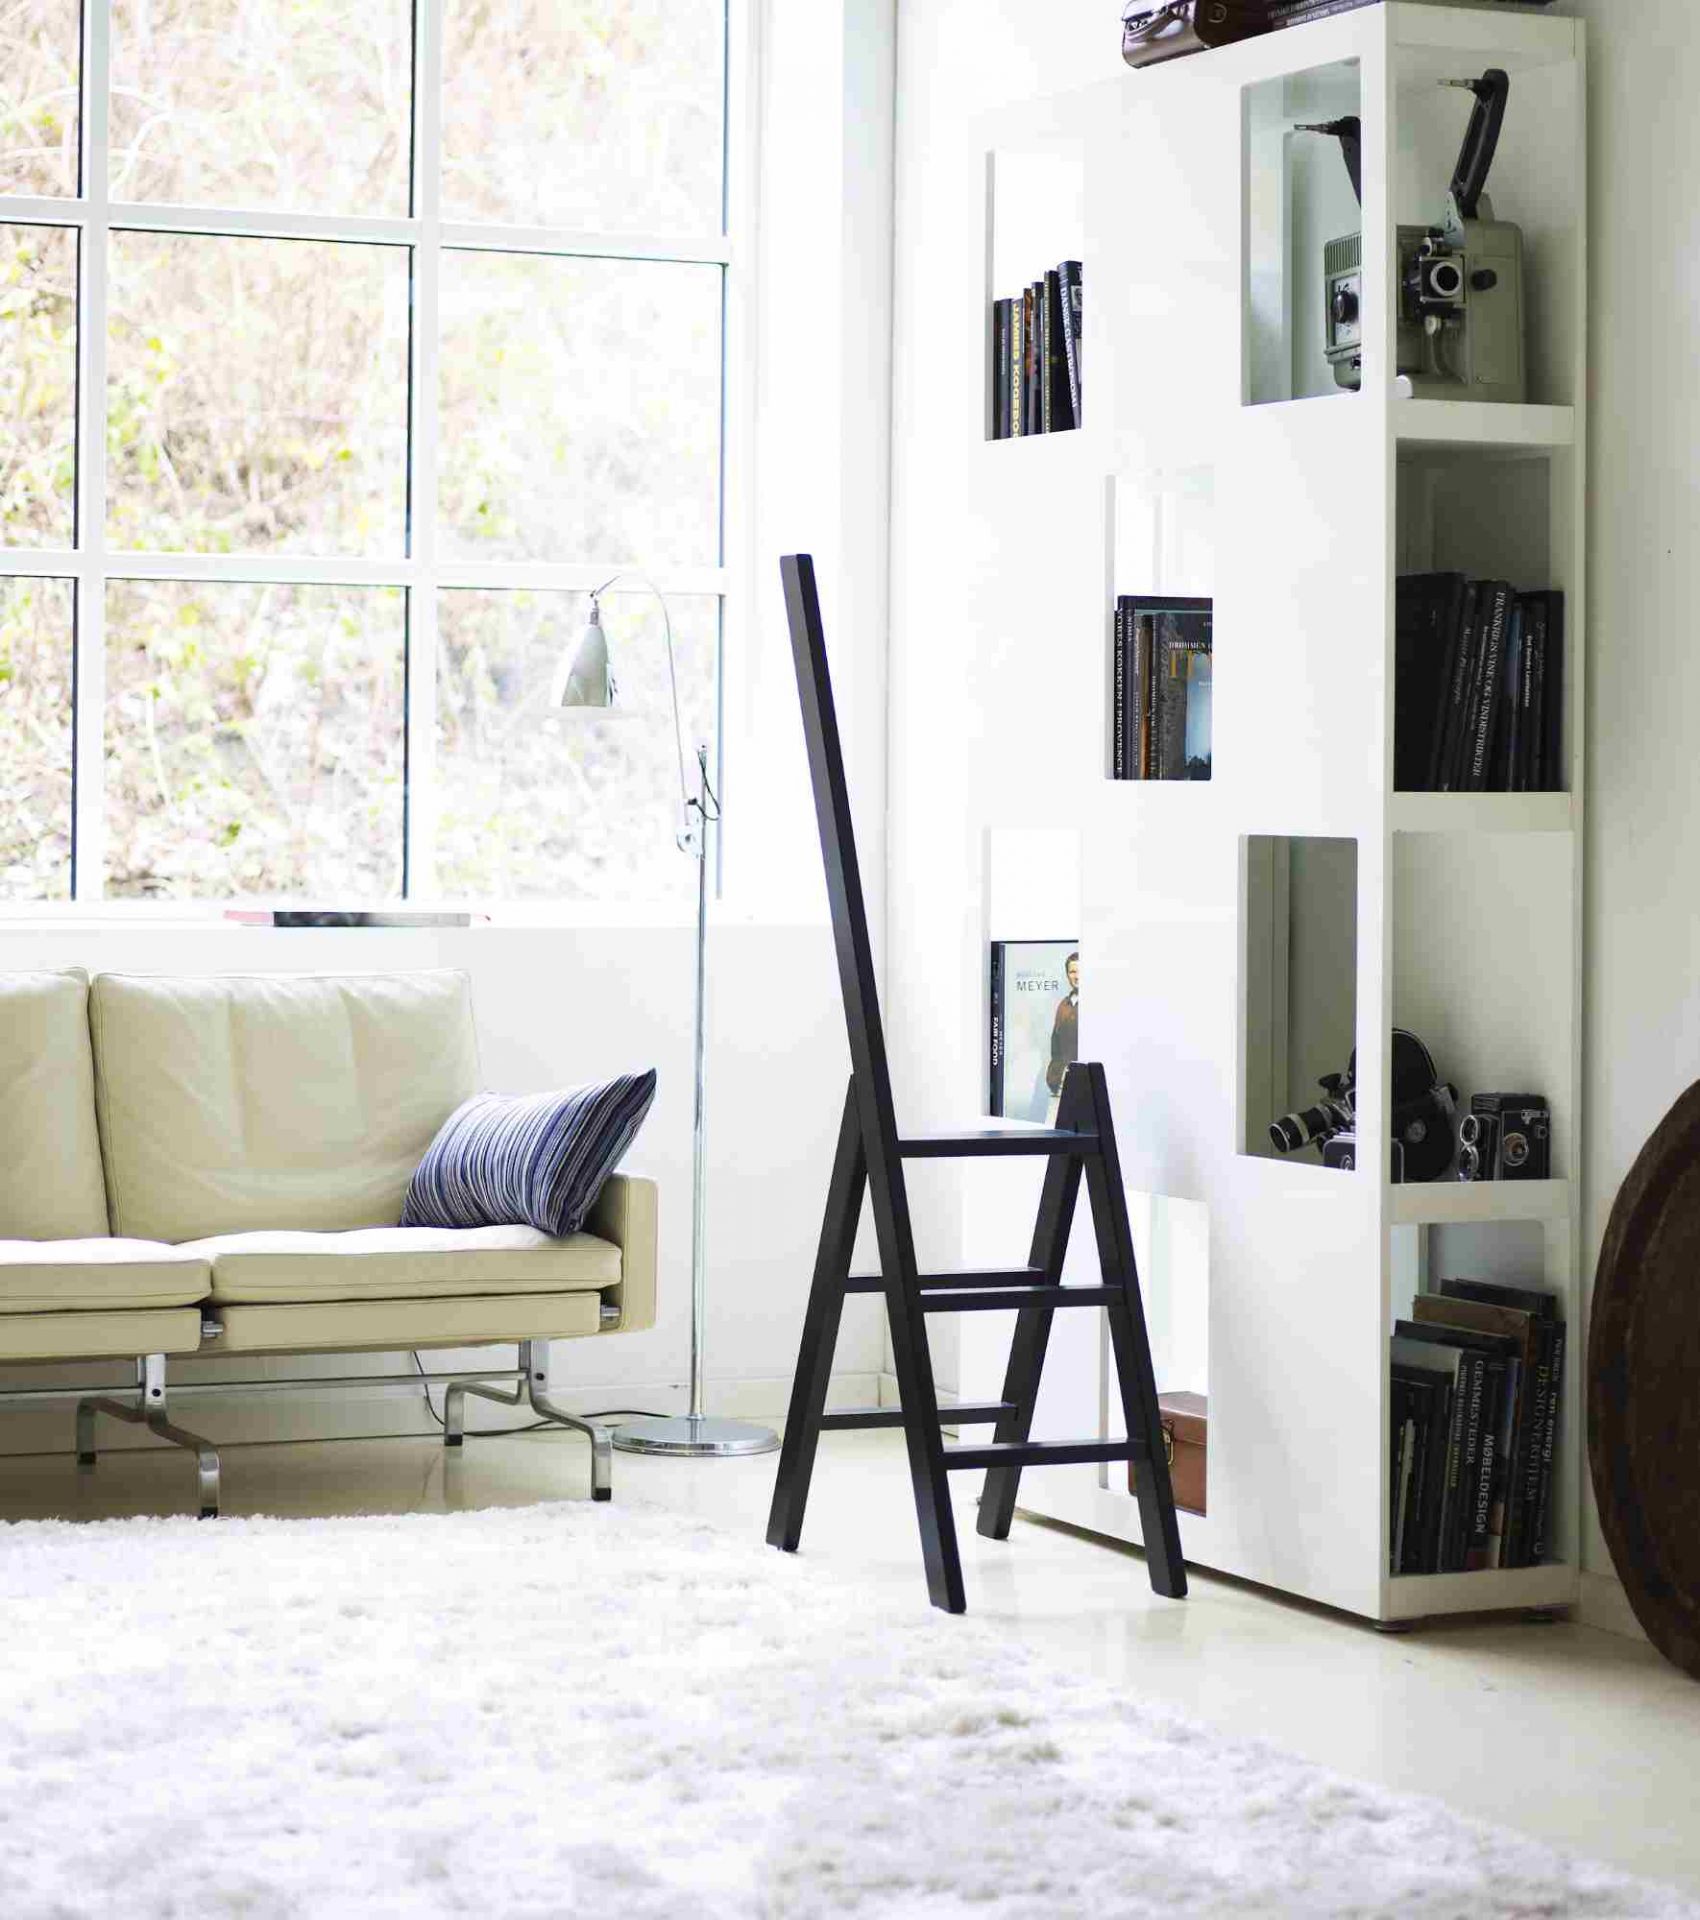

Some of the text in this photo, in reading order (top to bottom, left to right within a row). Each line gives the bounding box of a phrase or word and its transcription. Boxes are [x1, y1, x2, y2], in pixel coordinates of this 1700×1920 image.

[1490, 592, 1506, 652] FRANKRIGS
[1016, 981, 1059, 991] MEYER
[1466, 1360, 1484, 1464] GEMMESTEDER
[1475, 1434, 1495, 1533] MØBELDESIGN
